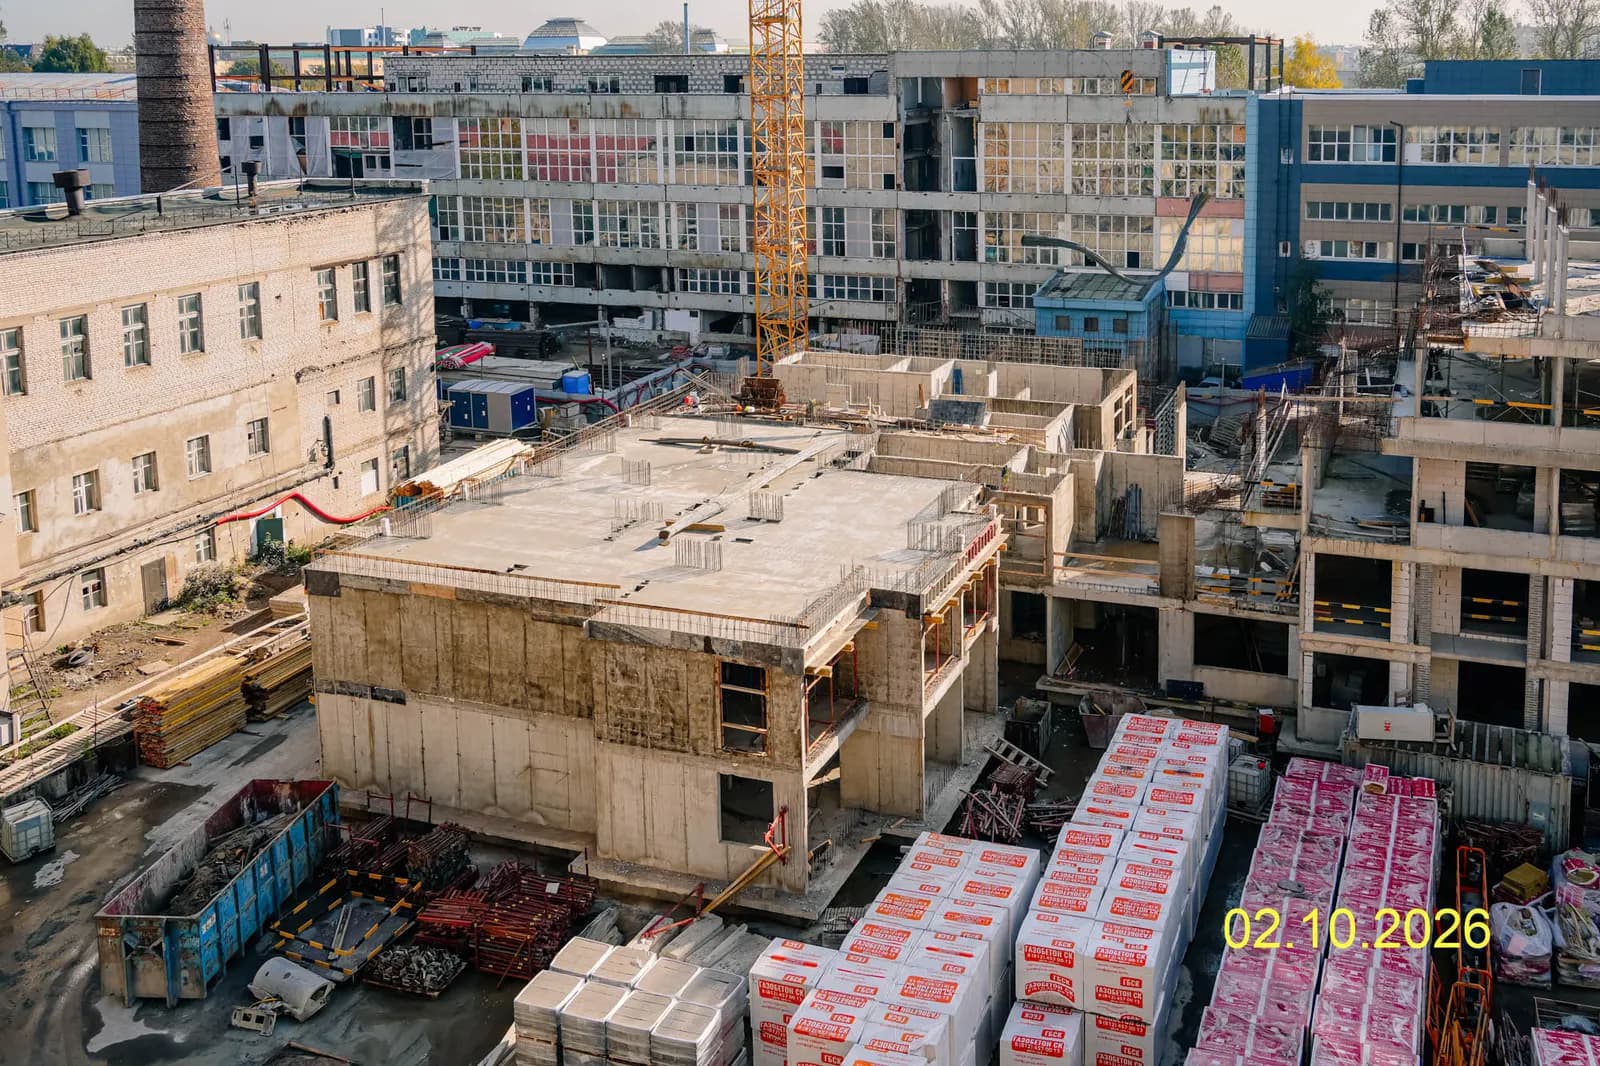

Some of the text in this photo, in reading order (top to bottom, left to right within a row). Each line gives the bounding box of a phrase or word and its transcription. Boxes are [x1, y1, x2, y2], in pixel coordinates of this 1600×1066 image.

[1122, 978, 1140, 987] ГБСК
[1013, 1035, 1063, 1050] ГАЗОБЕТОН СК
